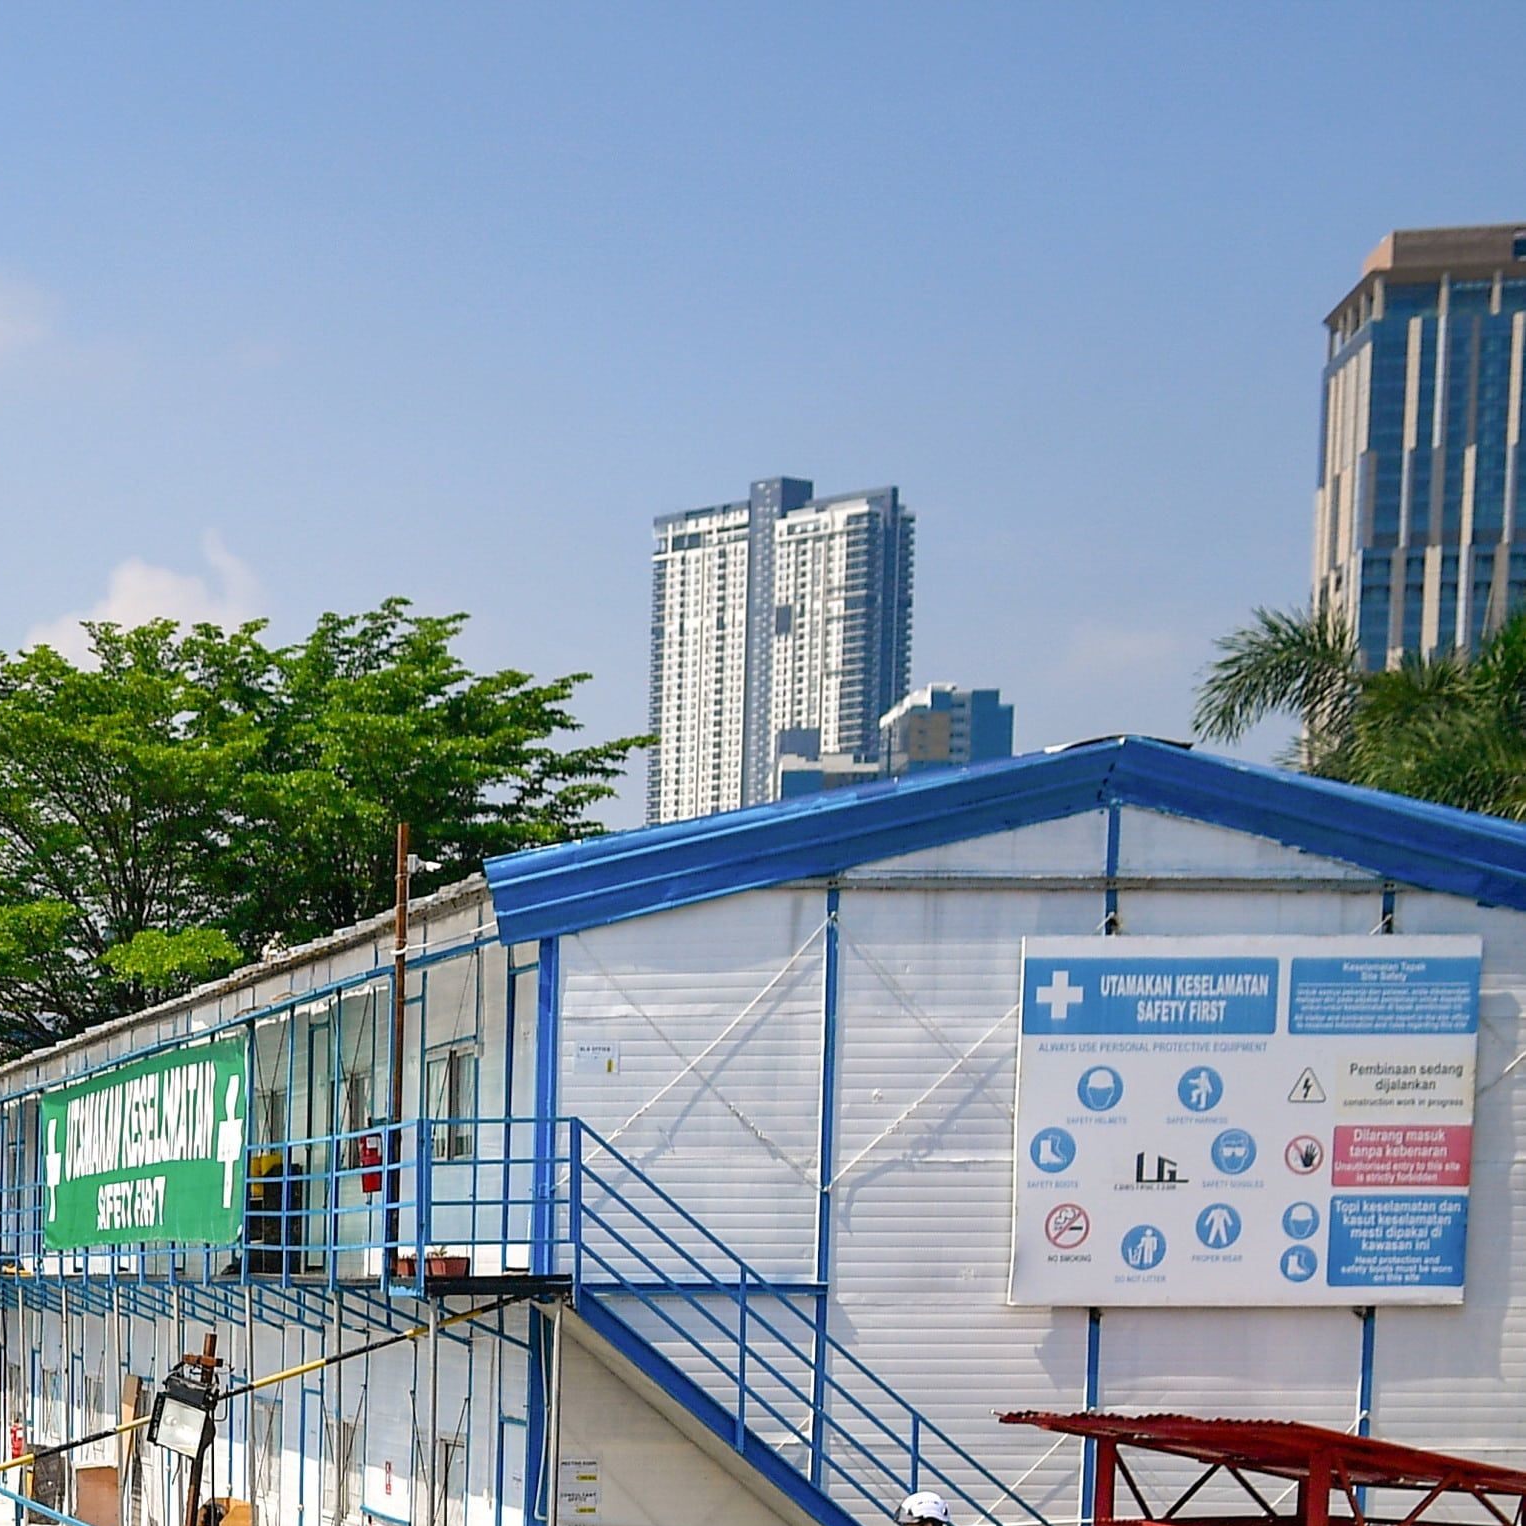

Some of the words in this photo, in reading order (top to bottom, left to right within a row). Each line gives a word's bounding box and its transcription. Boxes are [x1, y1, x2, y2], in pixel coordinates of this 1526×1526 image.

[1101, 975, 1172, 996] UTAMAKAN
[1176, 975, 1269, 997] KESELAMATAN
[1137, 1001, 1184, 1022] SAFETY
[1189, 1000, 1226, 1022] FIRST
[1038, 1042, 1076, 1052] ALWAYS
[1078, 1042, 1097, 1052] USE
[1099, 1042, 1149, 1052] PERSONAL
[1152, 1042, 1211, 1052] PROTECTIVE
[1213, 1042, 1267, 1052] EQUIPMENT
[1349, 1063, 1416, 1075] Pembinaan
[1421, 1063, 1463, 1076] sedang
[1375, 1080, 1435, 1094] dijalankan
[1427, 1100, 1463, 1108] progress
[65, 1084, 122, 1182] UTAMAKAN
[121, 1061, 216, 1168] KESELAMATAN
[1353, 1128, 1403, 1144] Dilarang
[1406, 1129, 1445, 1142] masuk
[1349, 1146, 1385, 1158] tanpa
[1386, 1145, 1447, 1158] kebenaran
[97, 1180, 133, 1231] SAFETY
[1335, 1201, 1360, 1214] Topi
[1363, 1201, 1435, 1212] keselamatan
[1438, 1201, 1461, 1212] dan
[1343, 1214, 1376, 1225] kasut
[1378, 1214, 1451, 1225] keselamatan
[1350, 1228, 1383, 1238] mesti
[1386, 1228, 1427, 1240] dipakai
[1431, 1228, 1442, 1238] di
[1361, 1240, 1413, 1250] kawasan
[1415, 1240, 1431, 1250] ini
